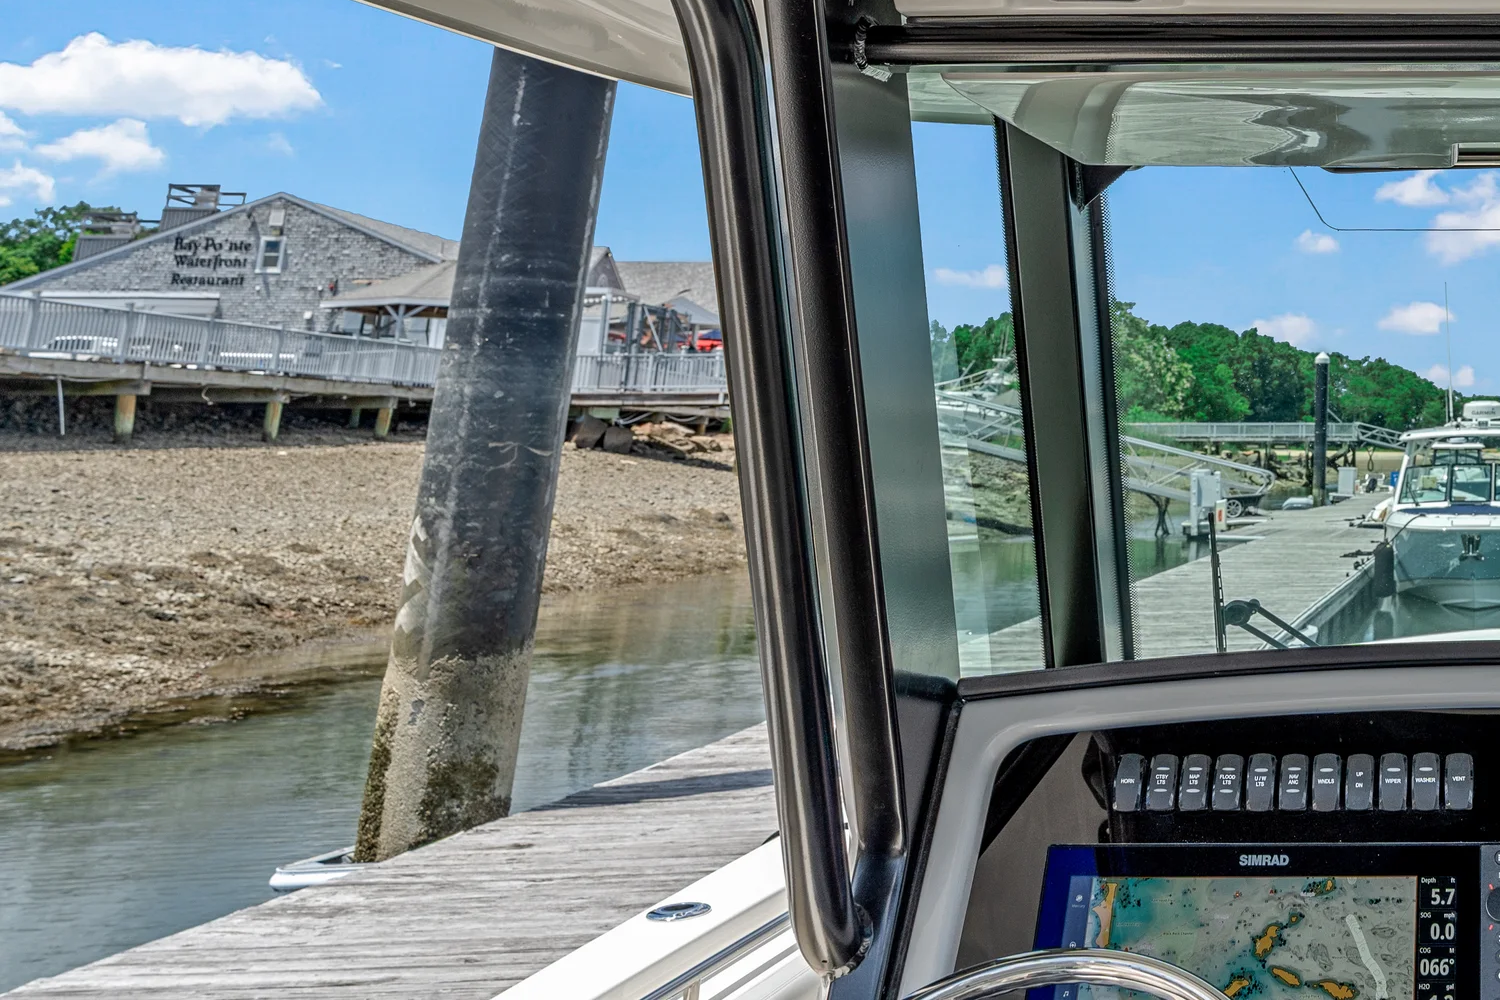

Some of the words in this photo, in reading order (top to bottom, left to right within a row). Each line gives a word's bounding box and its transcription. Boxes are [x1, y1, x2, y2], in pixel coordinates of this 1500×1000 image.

[174, 236, 200, 254] Bay
[204, 236, 252, 252] Ponte
[174, 254, 248, 270] Waterfront
[170, 273, 245, 286] Restaurant
[1239, 854, 1289, 866] SIMRAD
[1431, 888, 1455, 905] 5.7
[1430, 923, 1455, 940] 0.0
[1420, 958, 1455, 976] 066°
